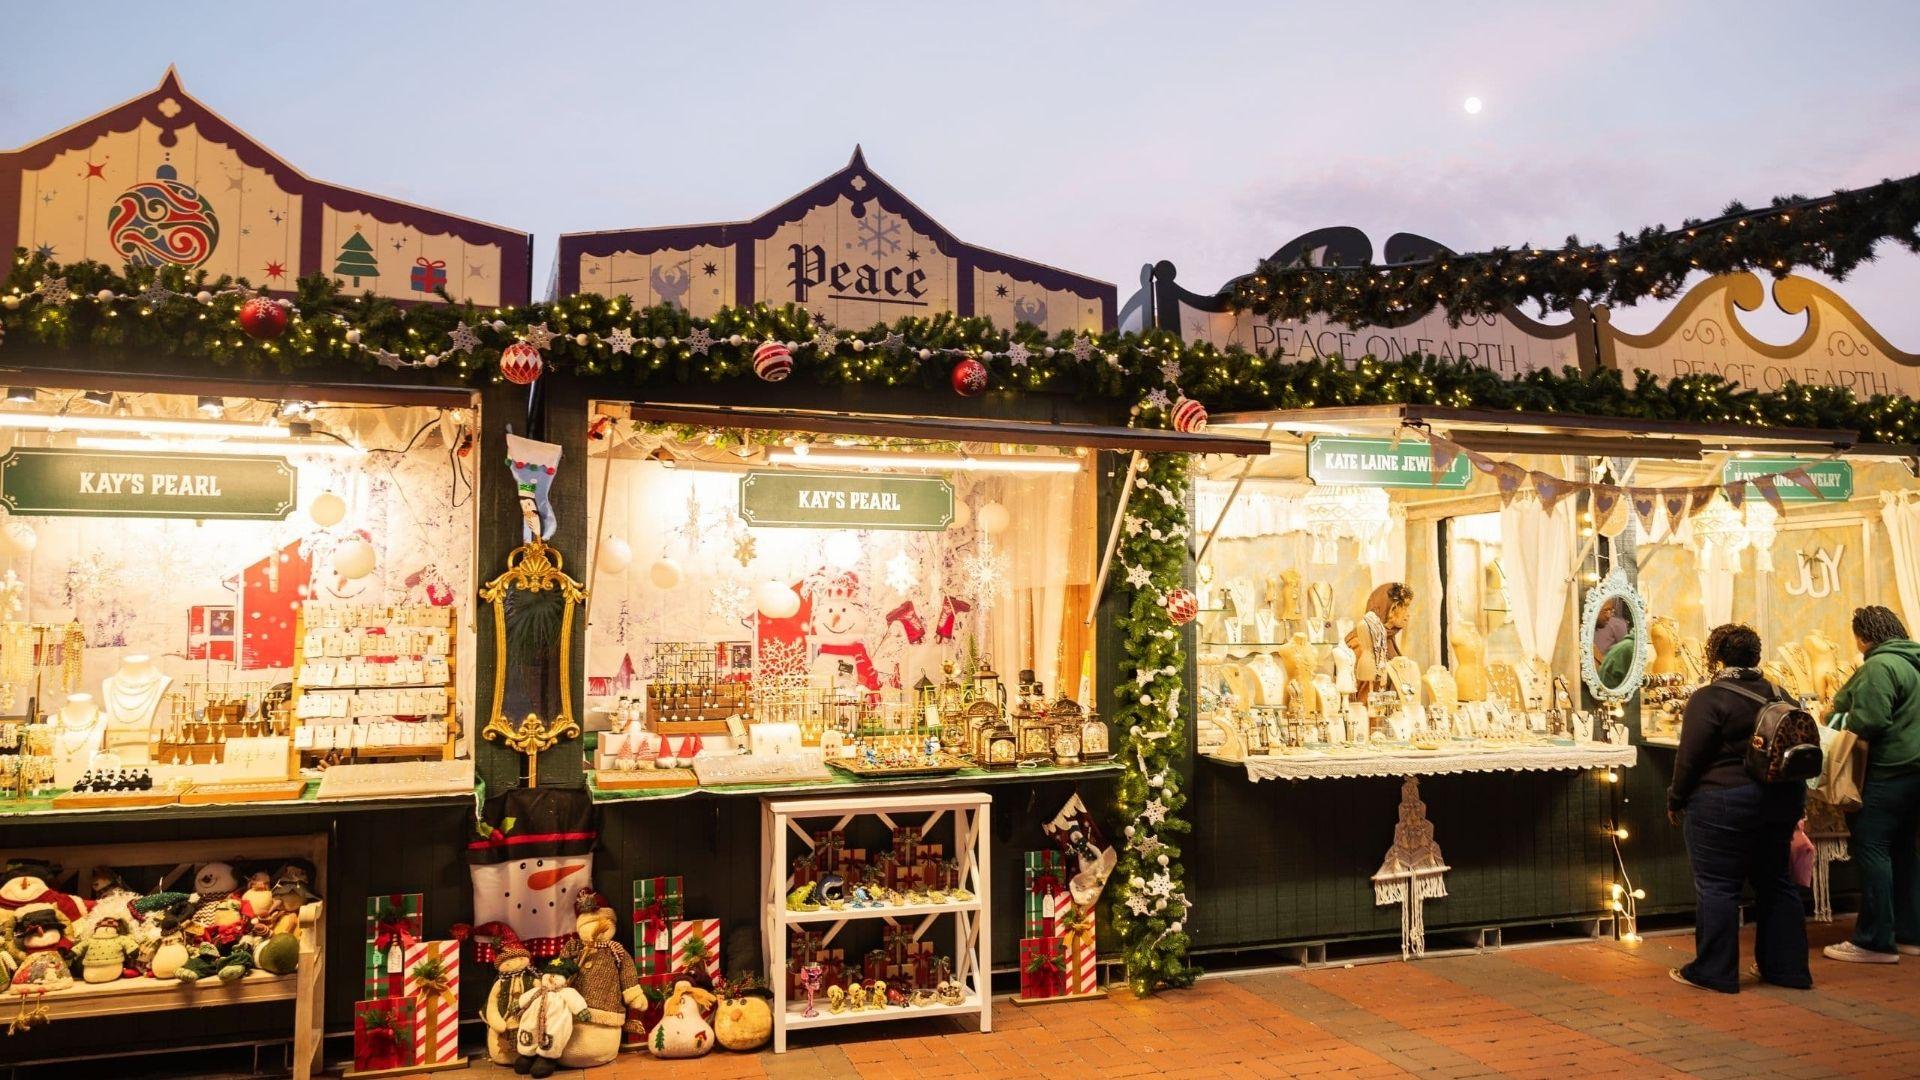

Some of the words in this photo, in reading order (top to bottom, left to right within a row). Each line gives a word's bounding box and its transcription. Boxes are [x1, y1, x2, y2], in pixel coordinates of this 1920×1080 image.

[787, 243, 928, 302] Peace
[1253, 325, 1358, 362] PEACE
[1366, 335, 1408, 363] ON
[1325, 453, 1358, 469] KATE
[1361, 454, 1398, 471] LAINE
[79, 472, 144, 494] KAY'S
[151, 475, 221, 496] PEARL
[799, 490, 845, 509] KAY'S
[850, 492, 900, 511] PEARL
